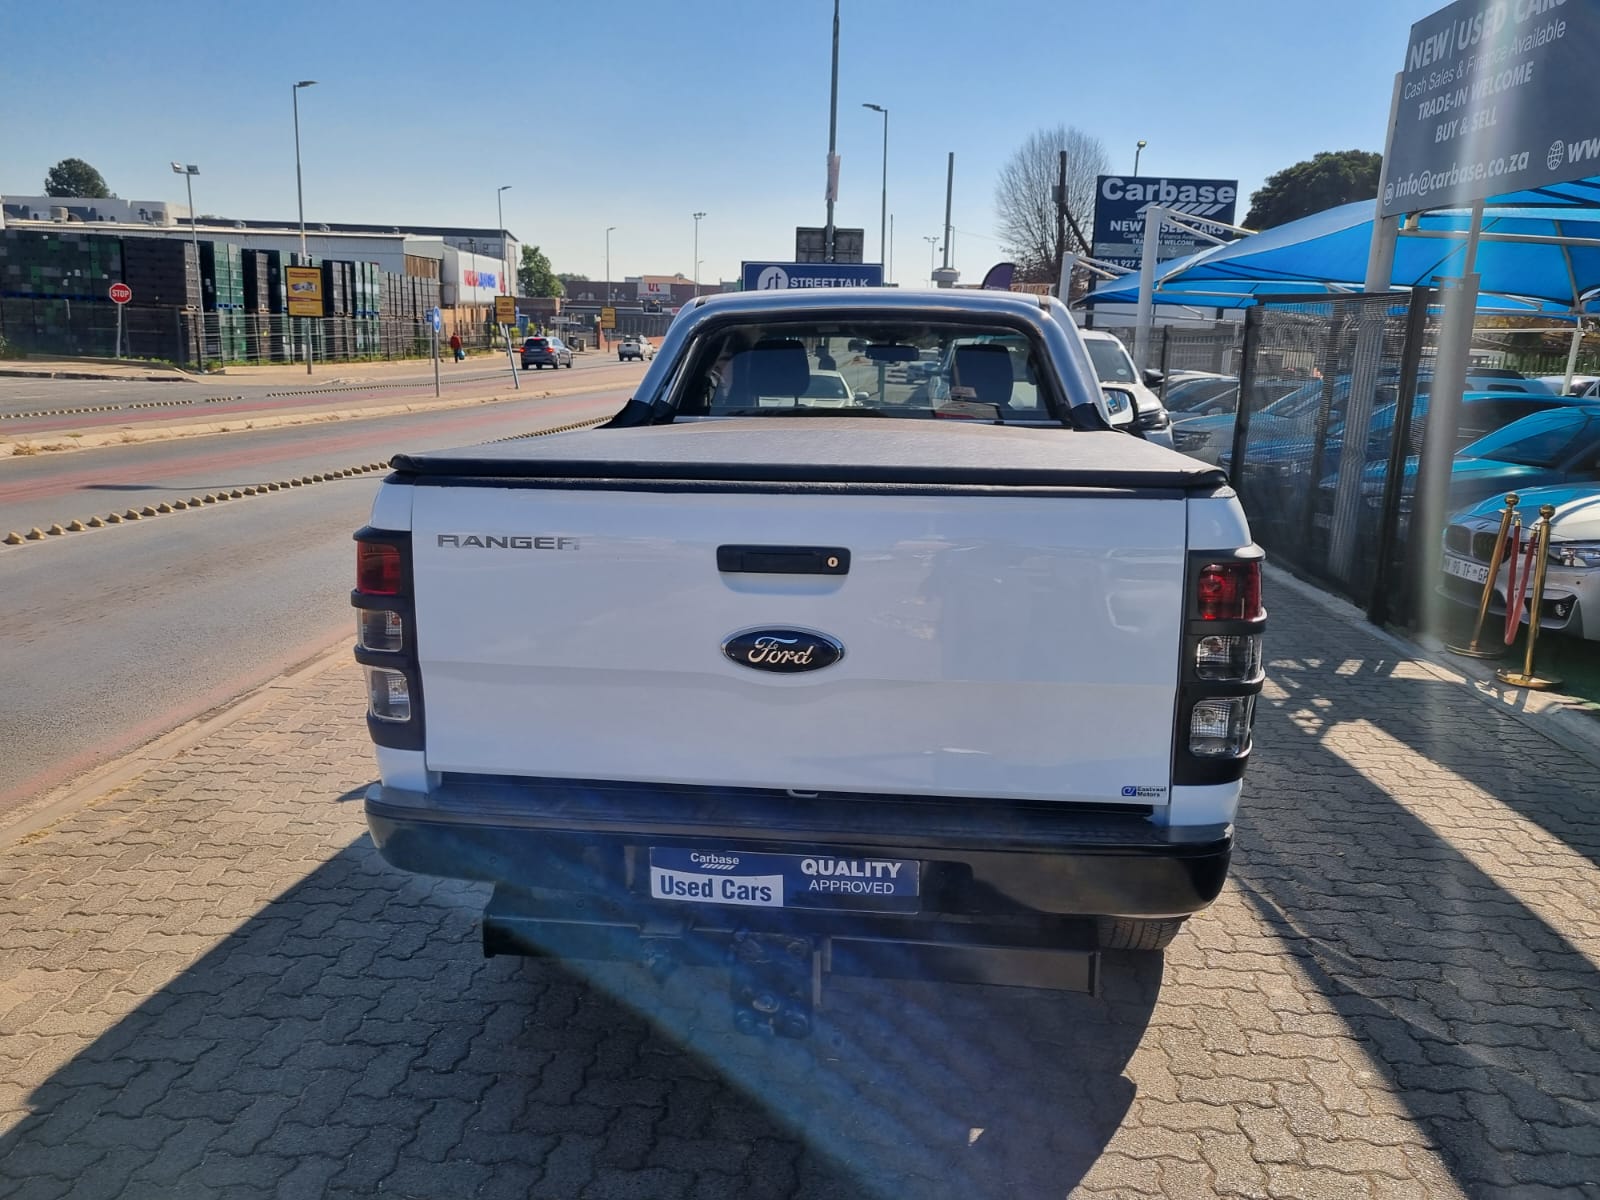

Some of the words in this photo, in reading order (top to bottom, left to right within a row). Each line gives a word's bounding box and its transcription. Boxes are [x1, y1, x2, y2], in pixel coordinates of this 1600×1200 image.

[1408, 27, 1449, 72] NEW
[1458, 3, 1506, 50] USED
[1404, 78, 1427, 100] Cash
[1428, 67, 1454, 91] Sales
[1456, 63, 1464, 80] &
[1510, 18, 1566, 55] Available
[1418, 86, 1469, 121] TRADE-IN
[1471, 61, 1534, 102] WELCOME
[1435, 120, 1459, 143] BUY
[1460, 118, 1470, 136] &
[1471, 107, 1497, 132] SELL
[1395, 151, 1530, 198] info@carbase.co.za
[1102, 177, 1236, 203] Carbase
[1109, 220, 1143, 232] NEW
[790, 277, 834, 288] STREET
[839, 278, 869, 288] TALK
[748, 636, 814, 665] Ford
[690, 852, 740, 865] Carbase
[801, 858, 902, 879] QUALITY
[660, 875, 714, 898] Used
[721, 879, 772, 902] Cars
[809, 879, 895, 895] APPROVED
